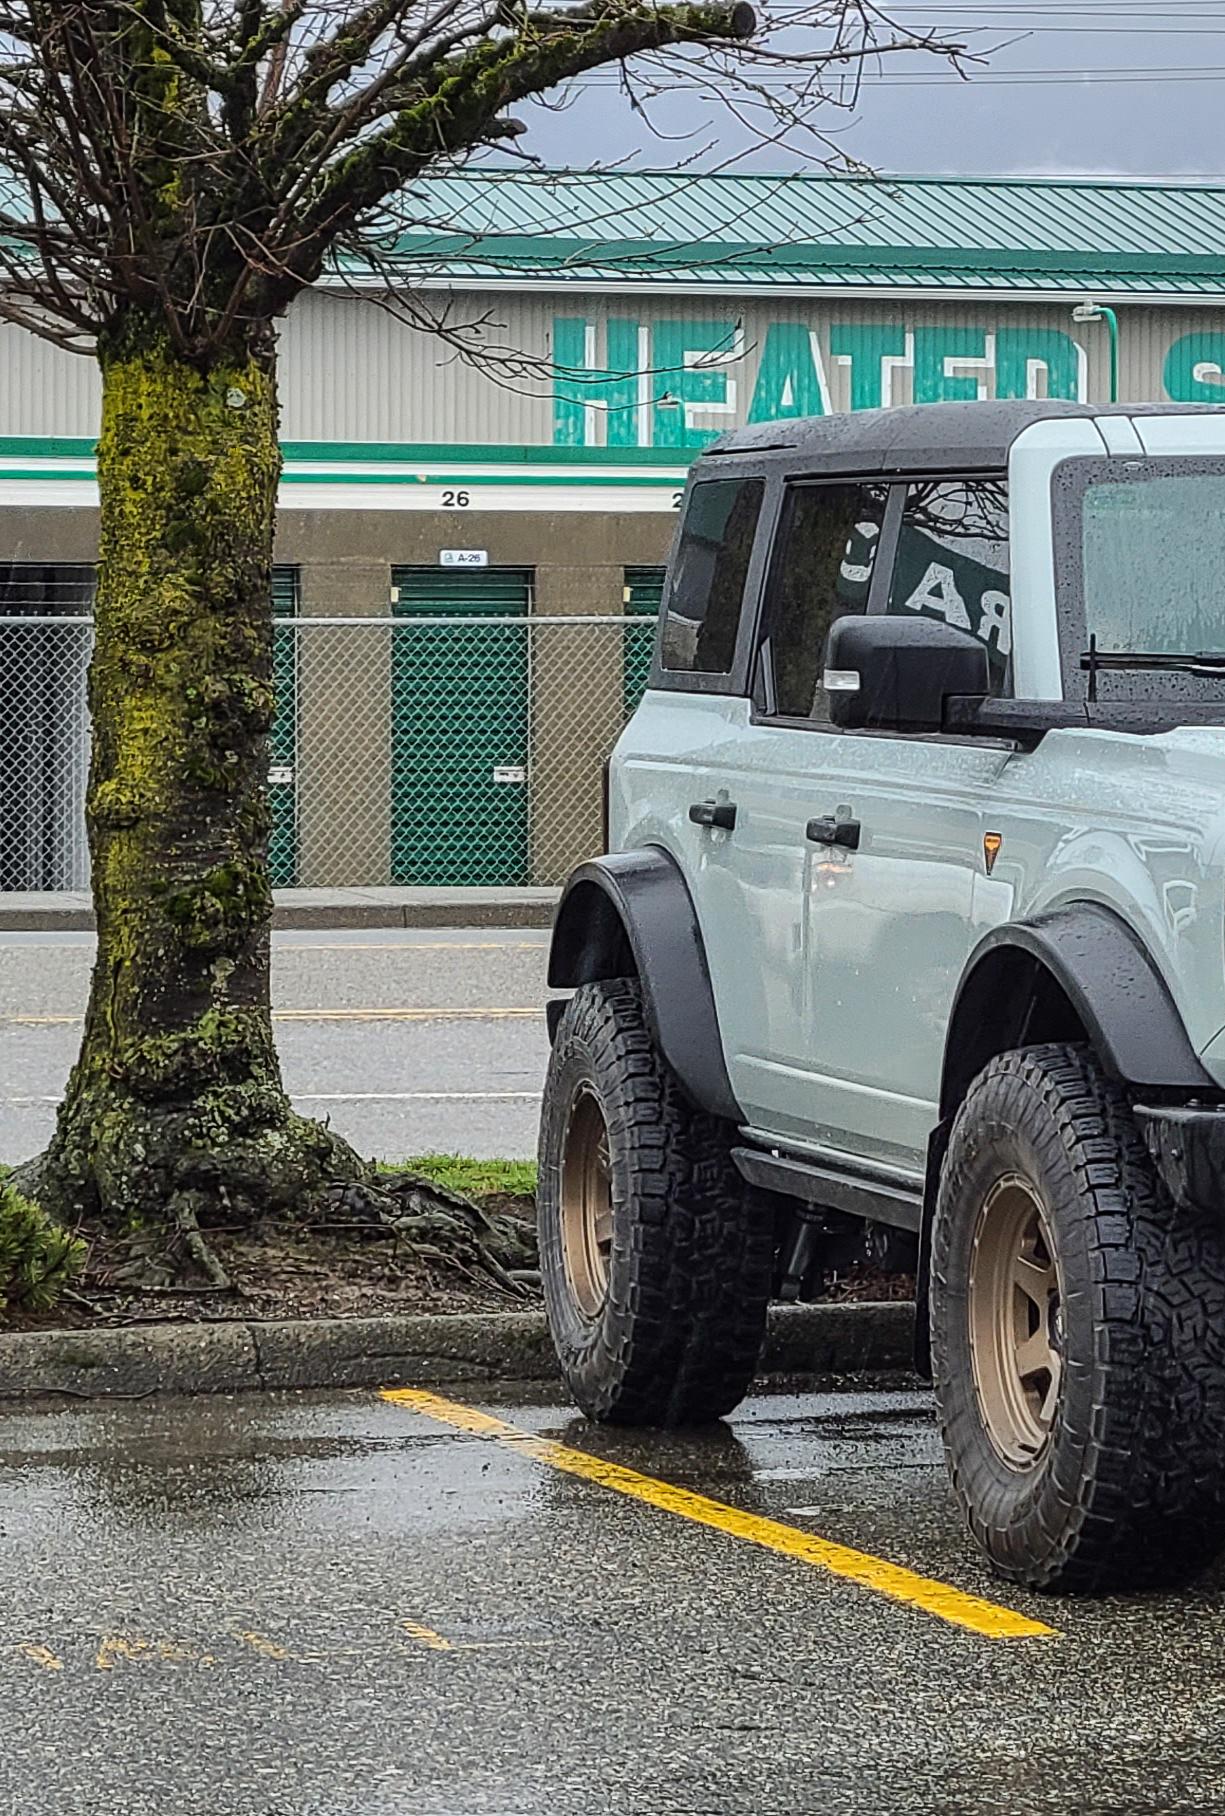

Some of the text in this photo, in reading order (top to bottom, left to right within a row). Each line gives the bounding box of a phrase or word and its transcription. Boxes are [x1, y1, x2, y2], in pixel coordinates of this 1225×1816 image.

[553, 317, 1085, 447] HEATED
[441, 490, 470, 507] 26
[672, 492, 684, 508] 2
[457, 553, 481, 563] A-26
